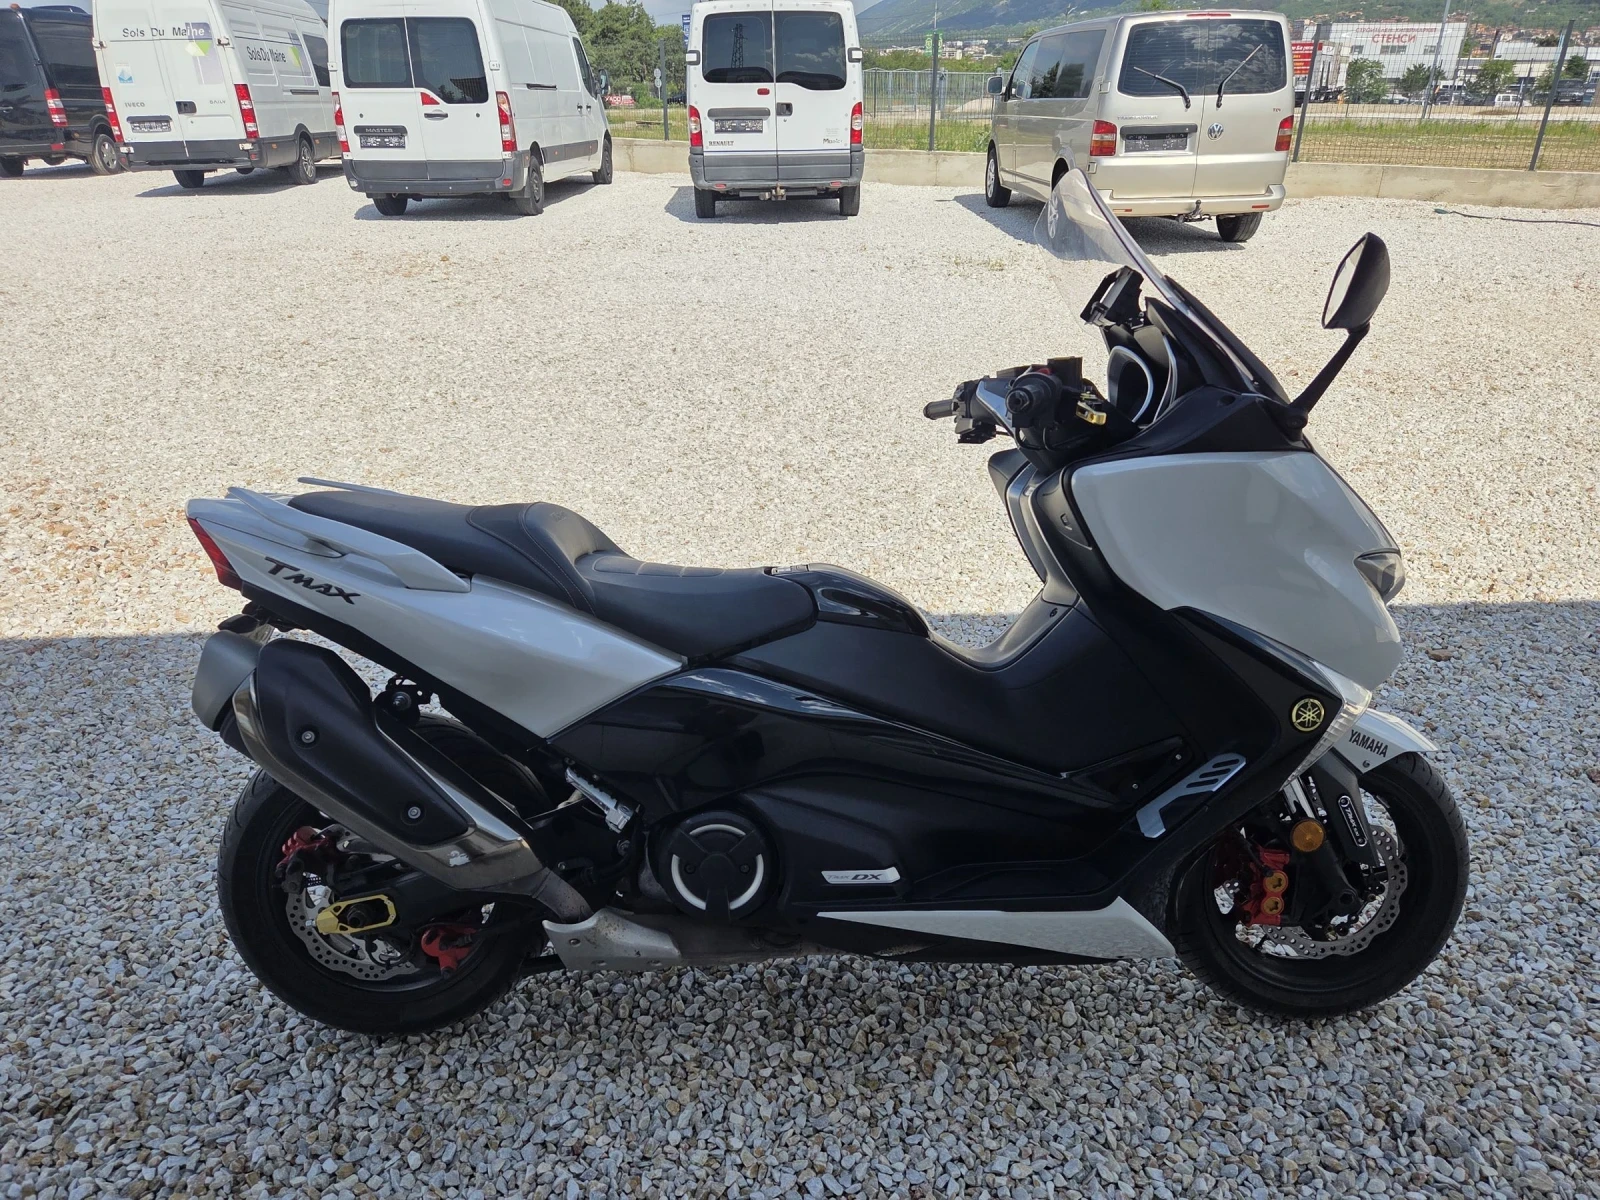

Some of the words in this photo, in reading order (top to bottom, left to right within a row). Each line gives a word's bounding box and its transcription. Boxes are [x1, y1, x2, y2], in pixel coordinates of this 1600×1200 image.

[122, 27, 145, 38] Sols
[150, 27, 165, 37] Du
[172, 26, 205, 37] Maine
[1371, 33, 1417, 44] СТЕНСИ
[246, 45, 262, 61] Sols
[1348, 729, 1389, 758] YAMAHA
[851, 873, 882, 881] DX
